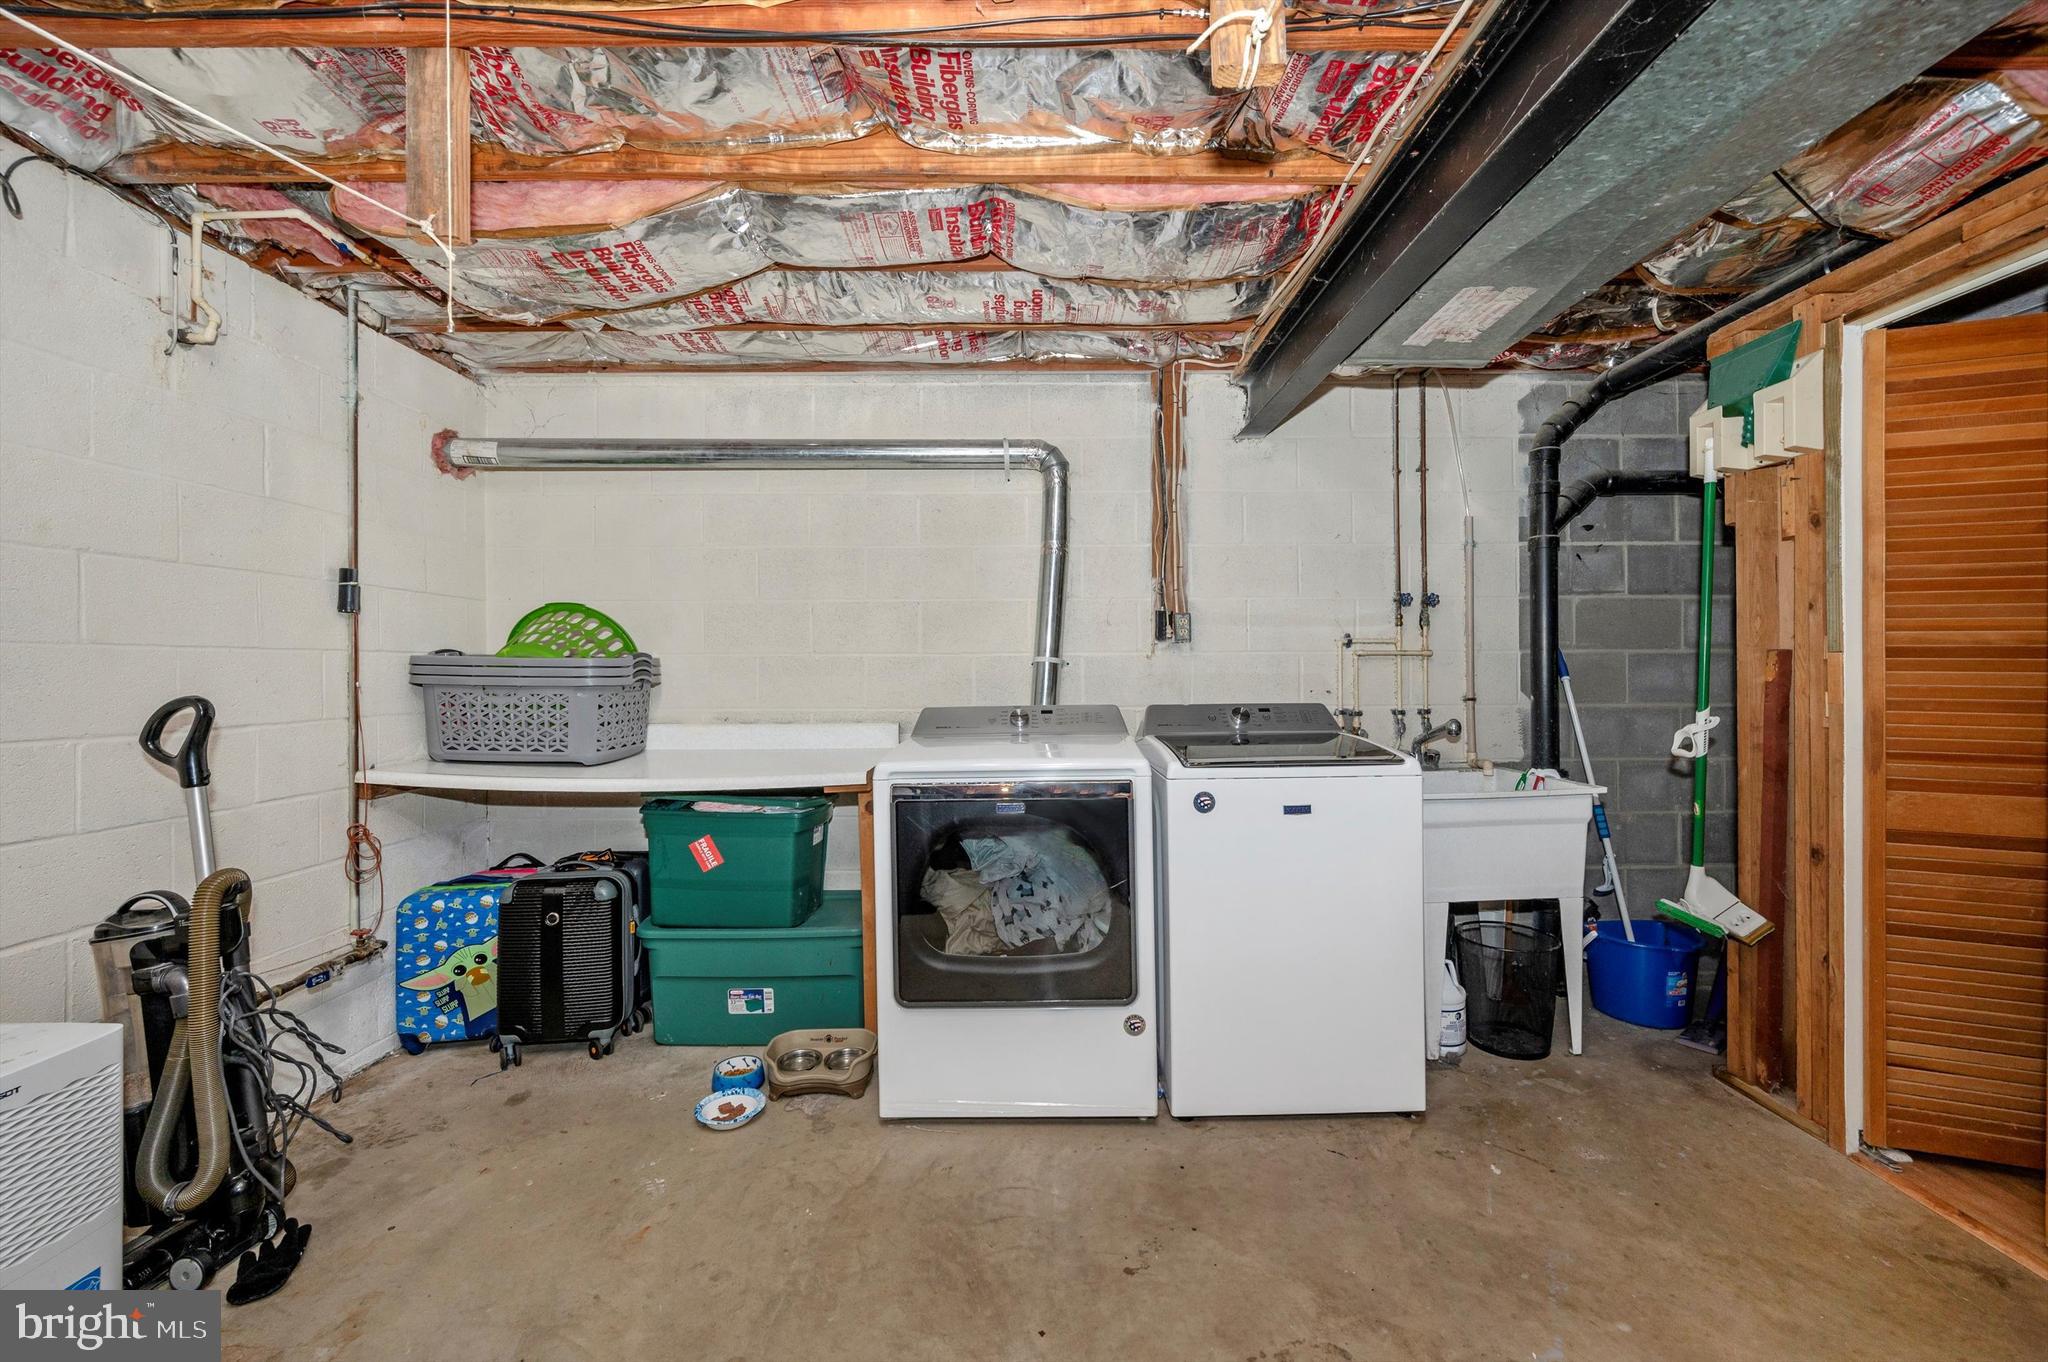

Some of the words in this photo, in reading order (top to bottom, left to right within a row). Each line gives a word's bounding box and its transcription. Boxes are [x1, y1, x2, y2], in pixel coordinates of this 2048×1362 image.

[909, 47, 938, 121] Building
[937, 51, 966, 130] Fiberglas
[961, 50, 979, 125] OWENS-CORNING
[1271, 52, 1304, 110] PERFORMANCE
[1287, 54, 1313, 97] ASSURED
[568, 250, 631, 302] Insulation
[590, 247, 644, 293] Building
[614, 241, 668, 294] Fiberglas
[632, 239, 677, 287] OWENS-CORNING
[698, 838, 718, 867] FRAGILE
